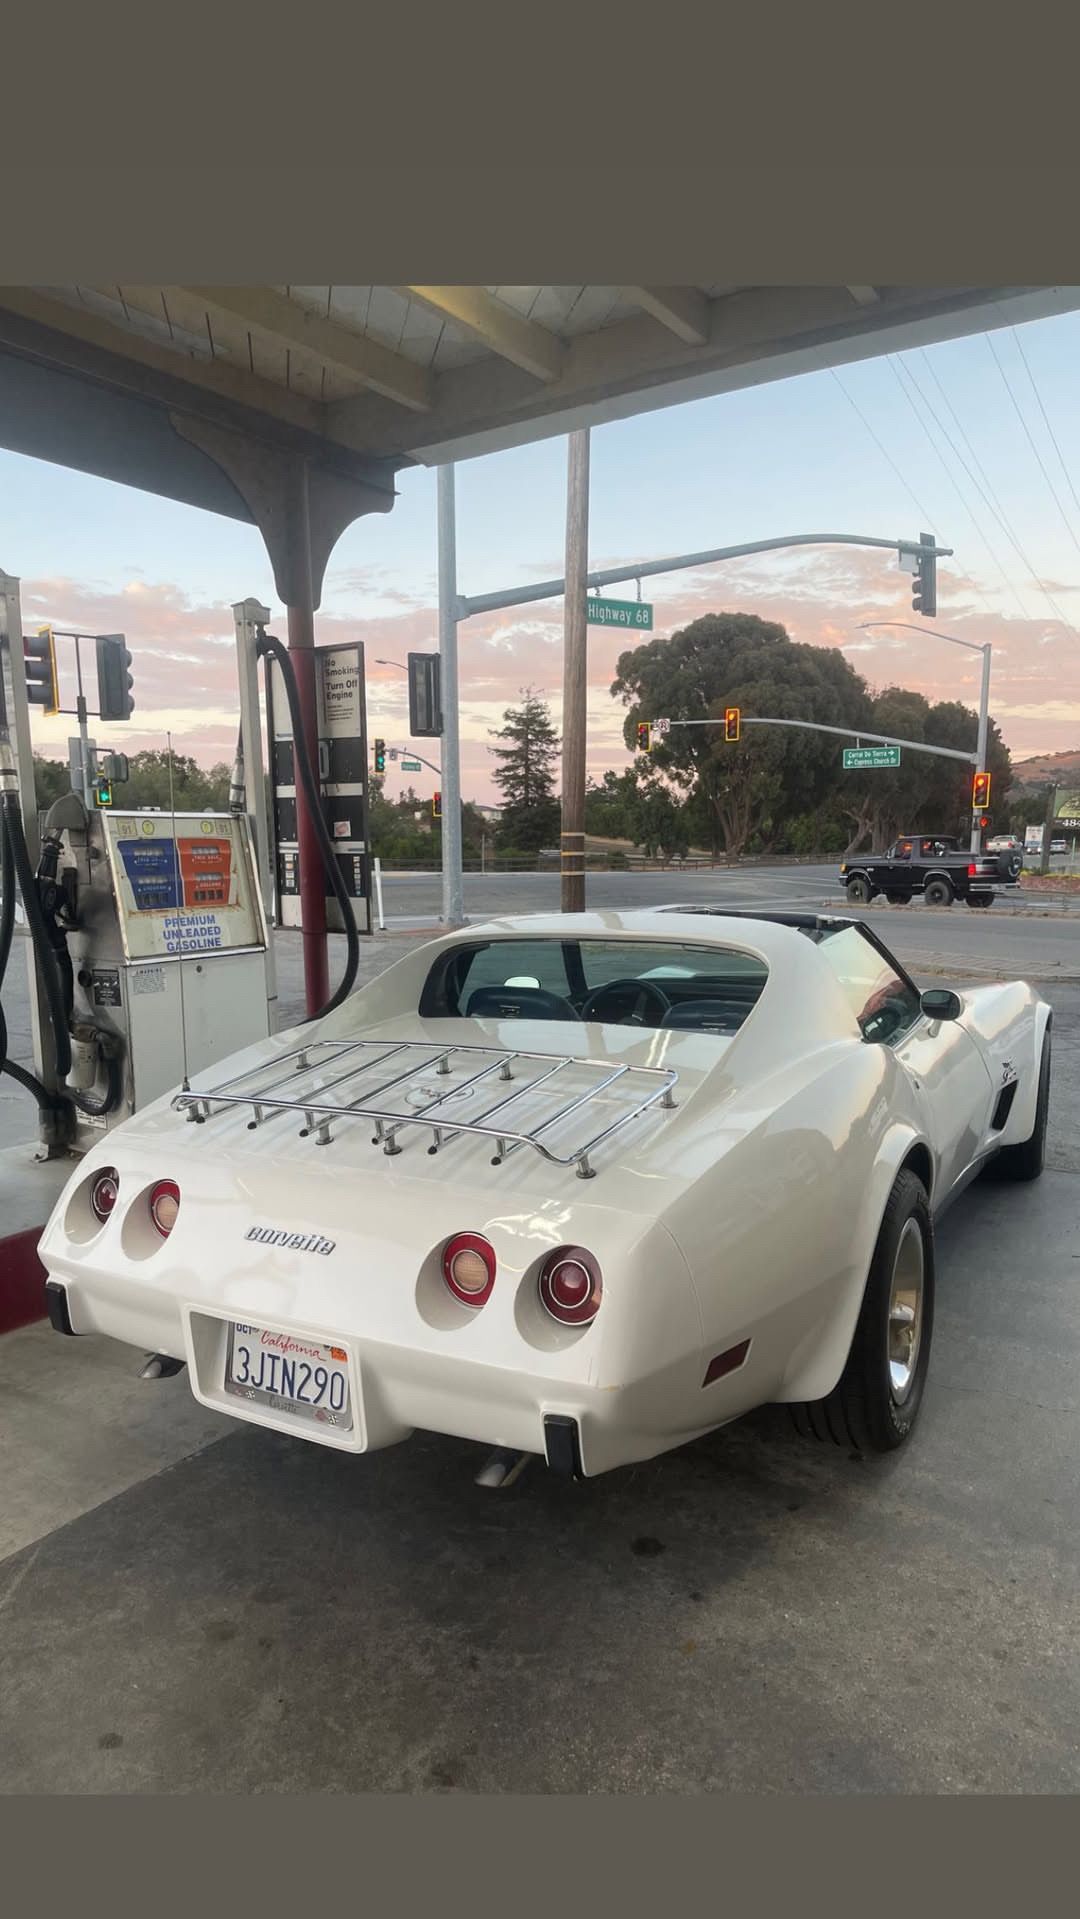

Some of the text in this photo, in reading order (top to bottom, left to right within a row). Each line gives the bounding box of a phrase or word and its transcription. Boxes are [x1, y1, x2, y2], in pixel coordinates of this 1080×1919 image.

[588, 603, 649, 625] Highway 68
[325, 658, 336, 668] No
[325, 665, 360, 677] Smoking
[325, 682, 344, 691] Turn
[345, 679, 358, 689] Off
[326, 690, 353, 701] Engine
[164, 914, 216, 928] PREMIUM
[162, 926, 221, 940] UNLEADED
[166, 937, 222, 952] GASOLINE
[260, 1330, 327, 1362] California
[236, 1346, 345, 1411] 3JIN290
